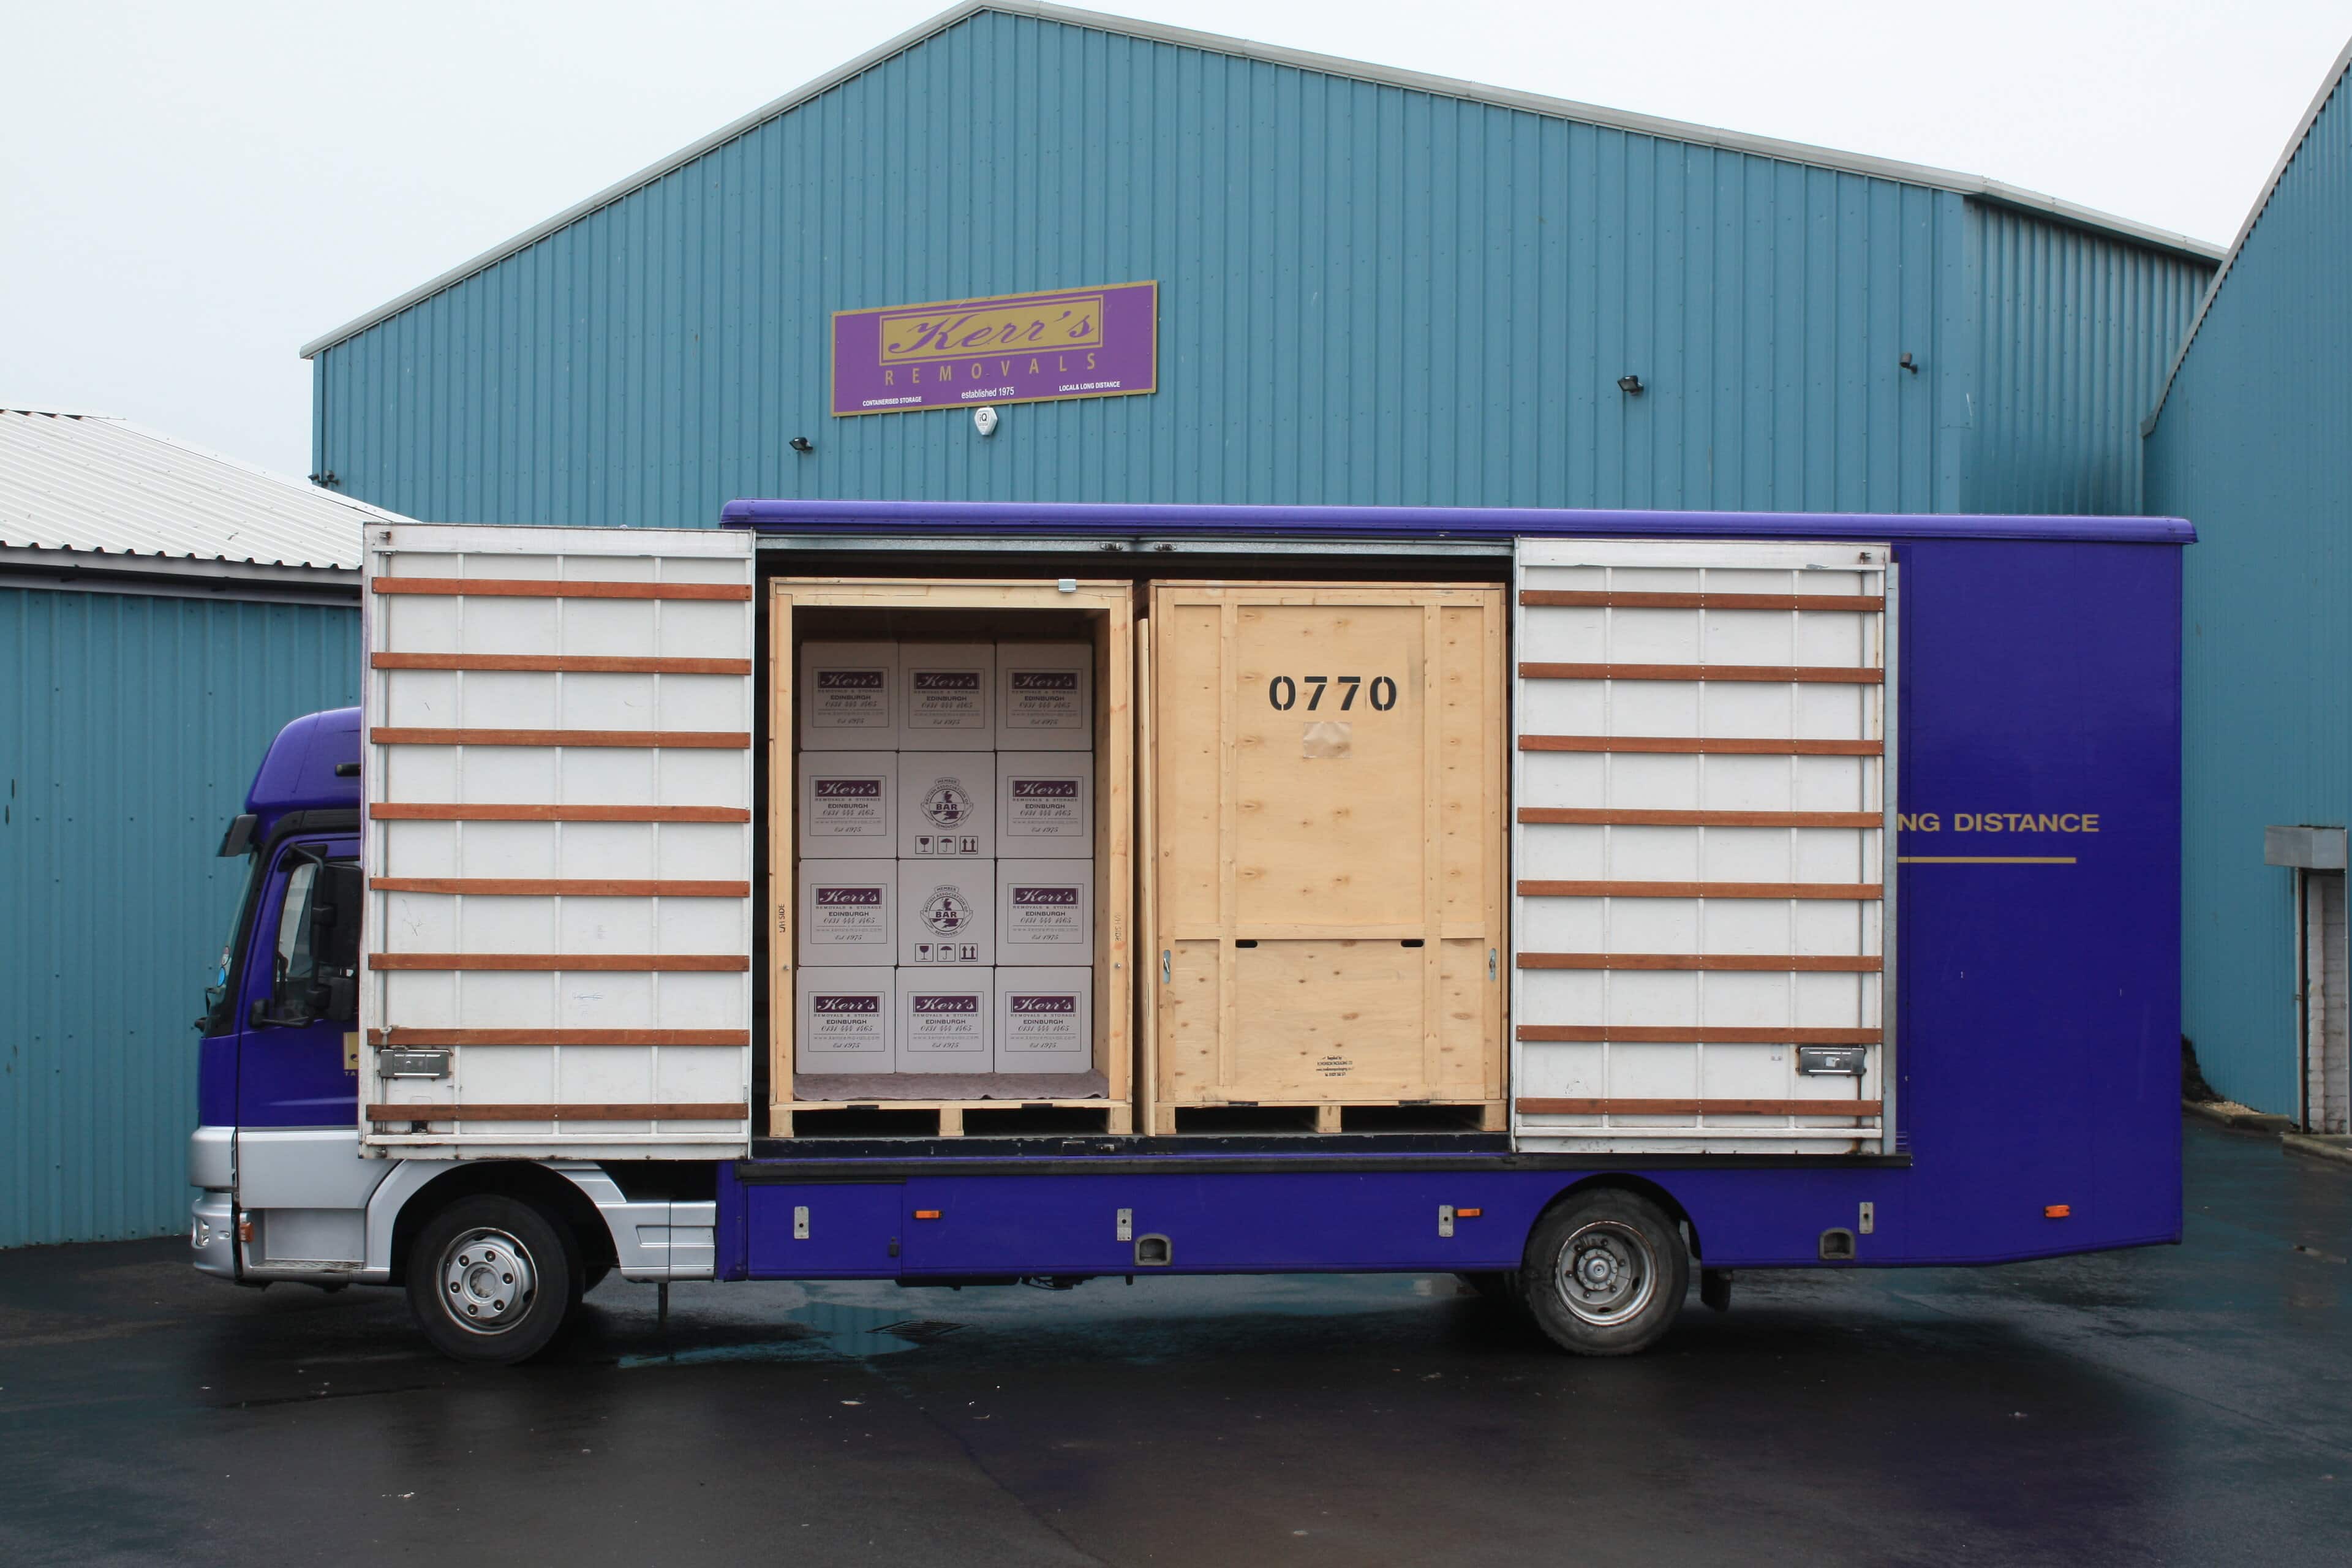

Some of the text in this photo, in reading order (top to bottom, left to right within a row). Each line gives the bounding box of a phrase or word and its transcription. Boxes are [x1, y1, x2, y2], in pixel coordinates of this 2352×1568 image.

[888, 311, 1094, 353] Kerr's
[885, 353, 1095, 386] REMOVALS
[961, 386, 1014, 399] established 1975
[862, 398, 899, 407] CONTAINERISED
[821, 673, 879, 685] Kerr's
[918, 674, 975, 687] Kerr's
[1016, 674, 1073, 687] Kerr's
[1269, 676, 1396, 711] 0770
[818, 782, 876, 794] Kerr's
[1016, 782, 1074, 794] Kerr's
[1898, 813, 2100, 832] NG DISTANCE
[820, 889, 878, 902] Kerr's
[1016, 889, 1074, 902] Kerr's
[817, 997, 875, 1009] Kerr's
[916, 997, 974, 1009] Kerr's
[1014, 998, 1072, 1009] Kerr's
